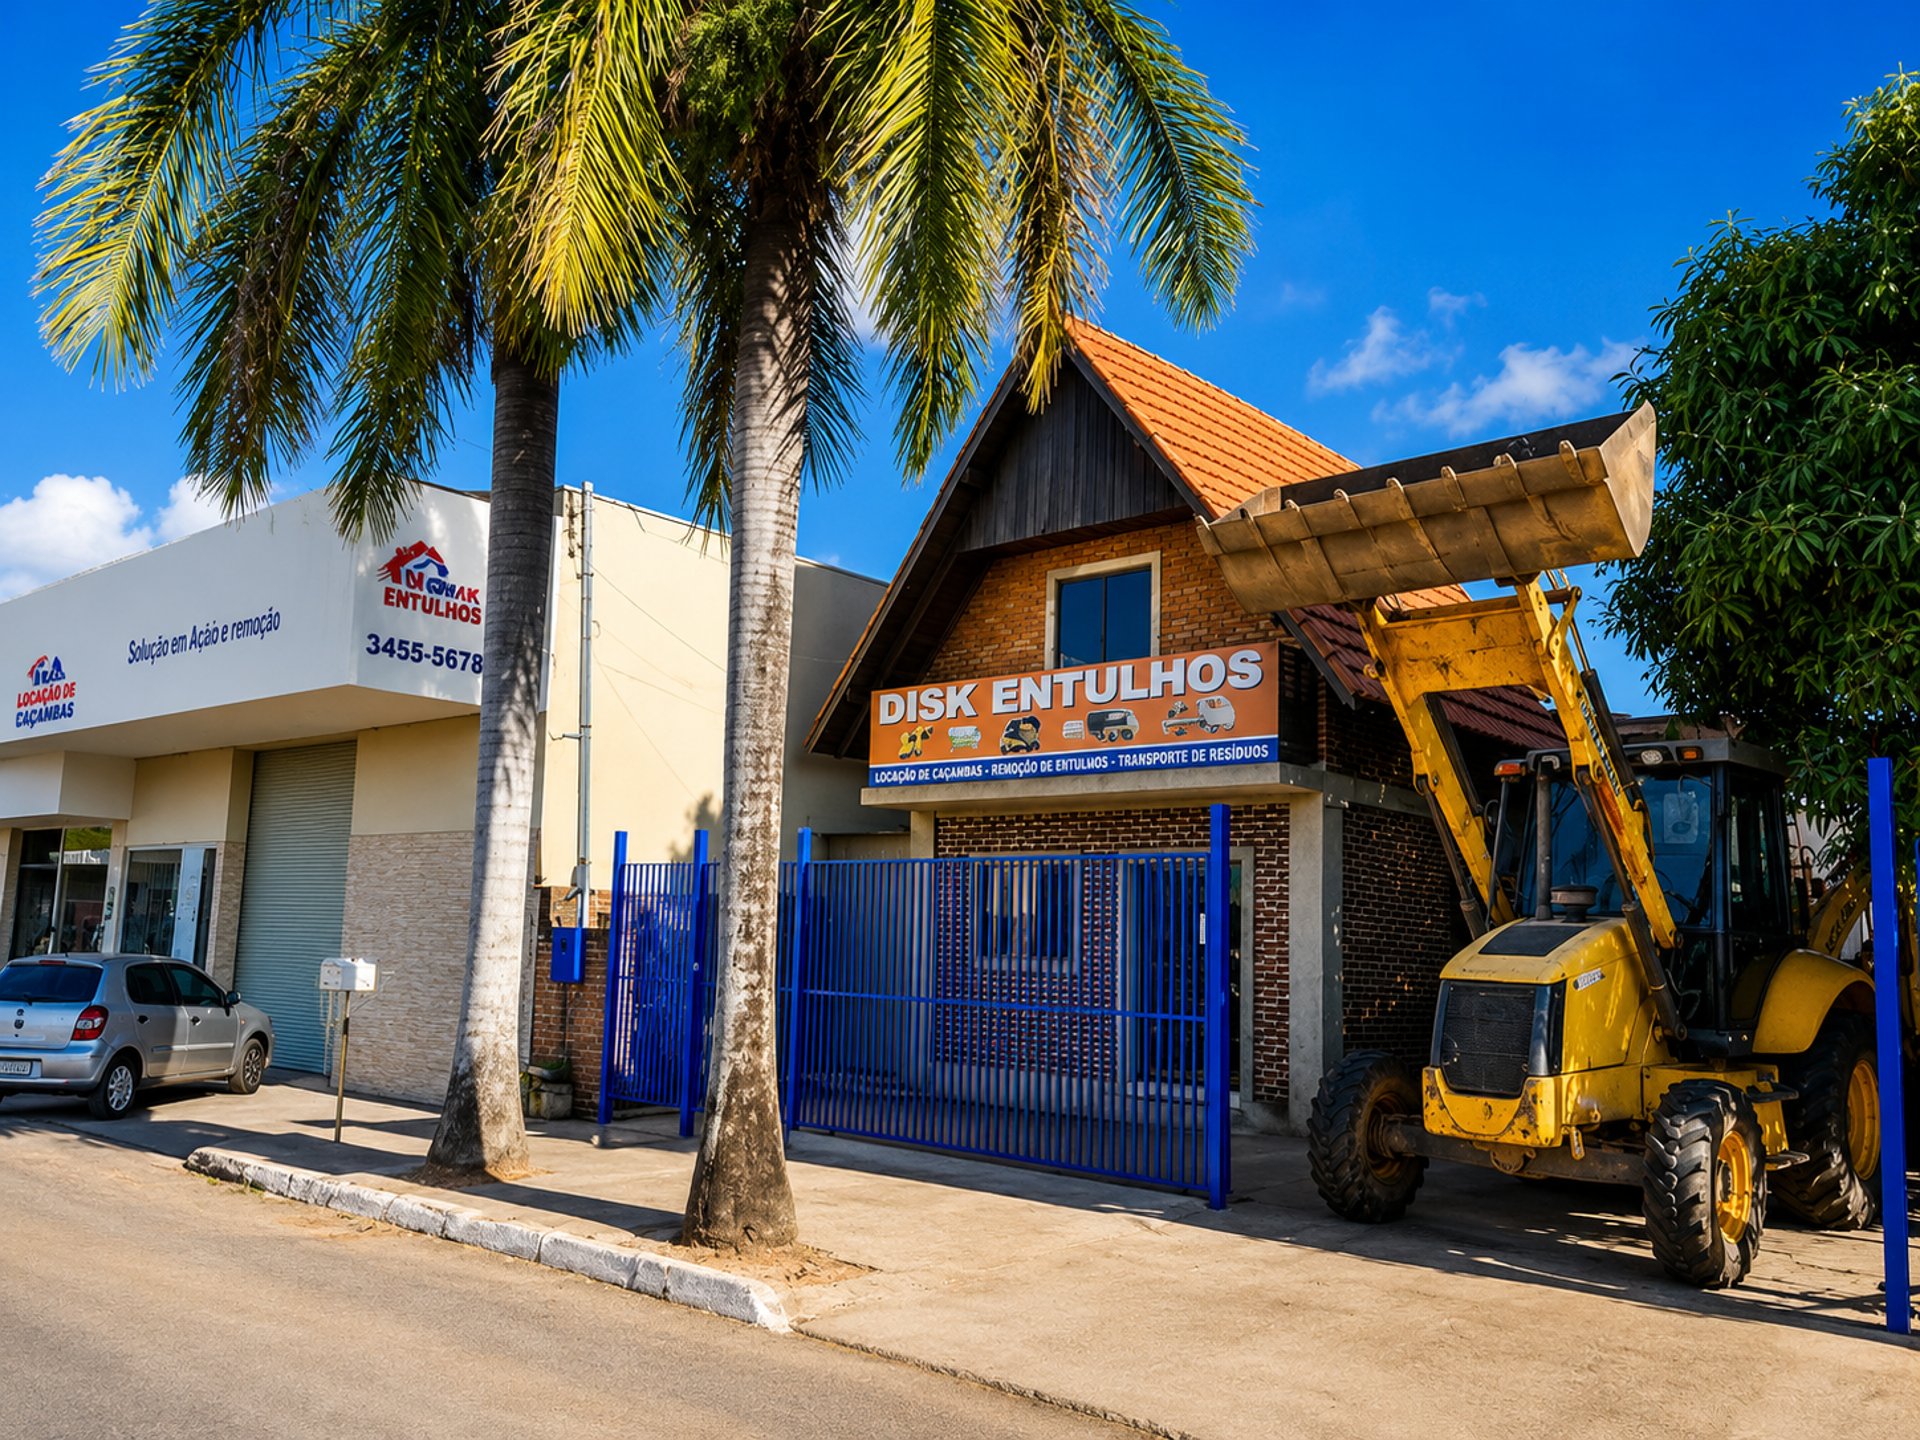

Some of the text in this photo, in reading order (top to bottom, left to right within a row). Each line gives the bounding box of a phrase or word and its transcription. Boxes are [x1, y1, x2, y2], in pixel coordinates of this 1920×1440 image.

[384, 587, 481, 625] ENTULHOS
[171, 634, 187, 655] em
[221, 623, 229, 643] e
[366, 633, 483, 675] 3455-5678
[63, 681, 76, 699] DE
[879, 650, 1264, 726] DISK ENTULHOS
[918, 768, 930, 780] DE
[1040, 760, 1053, 773] DE
[1118, 750, 1188, 766] TRANSPORTE
[1191, 749, 1206, 762] DE
[1209, 743, 1269, 762] RESÍDUOS
